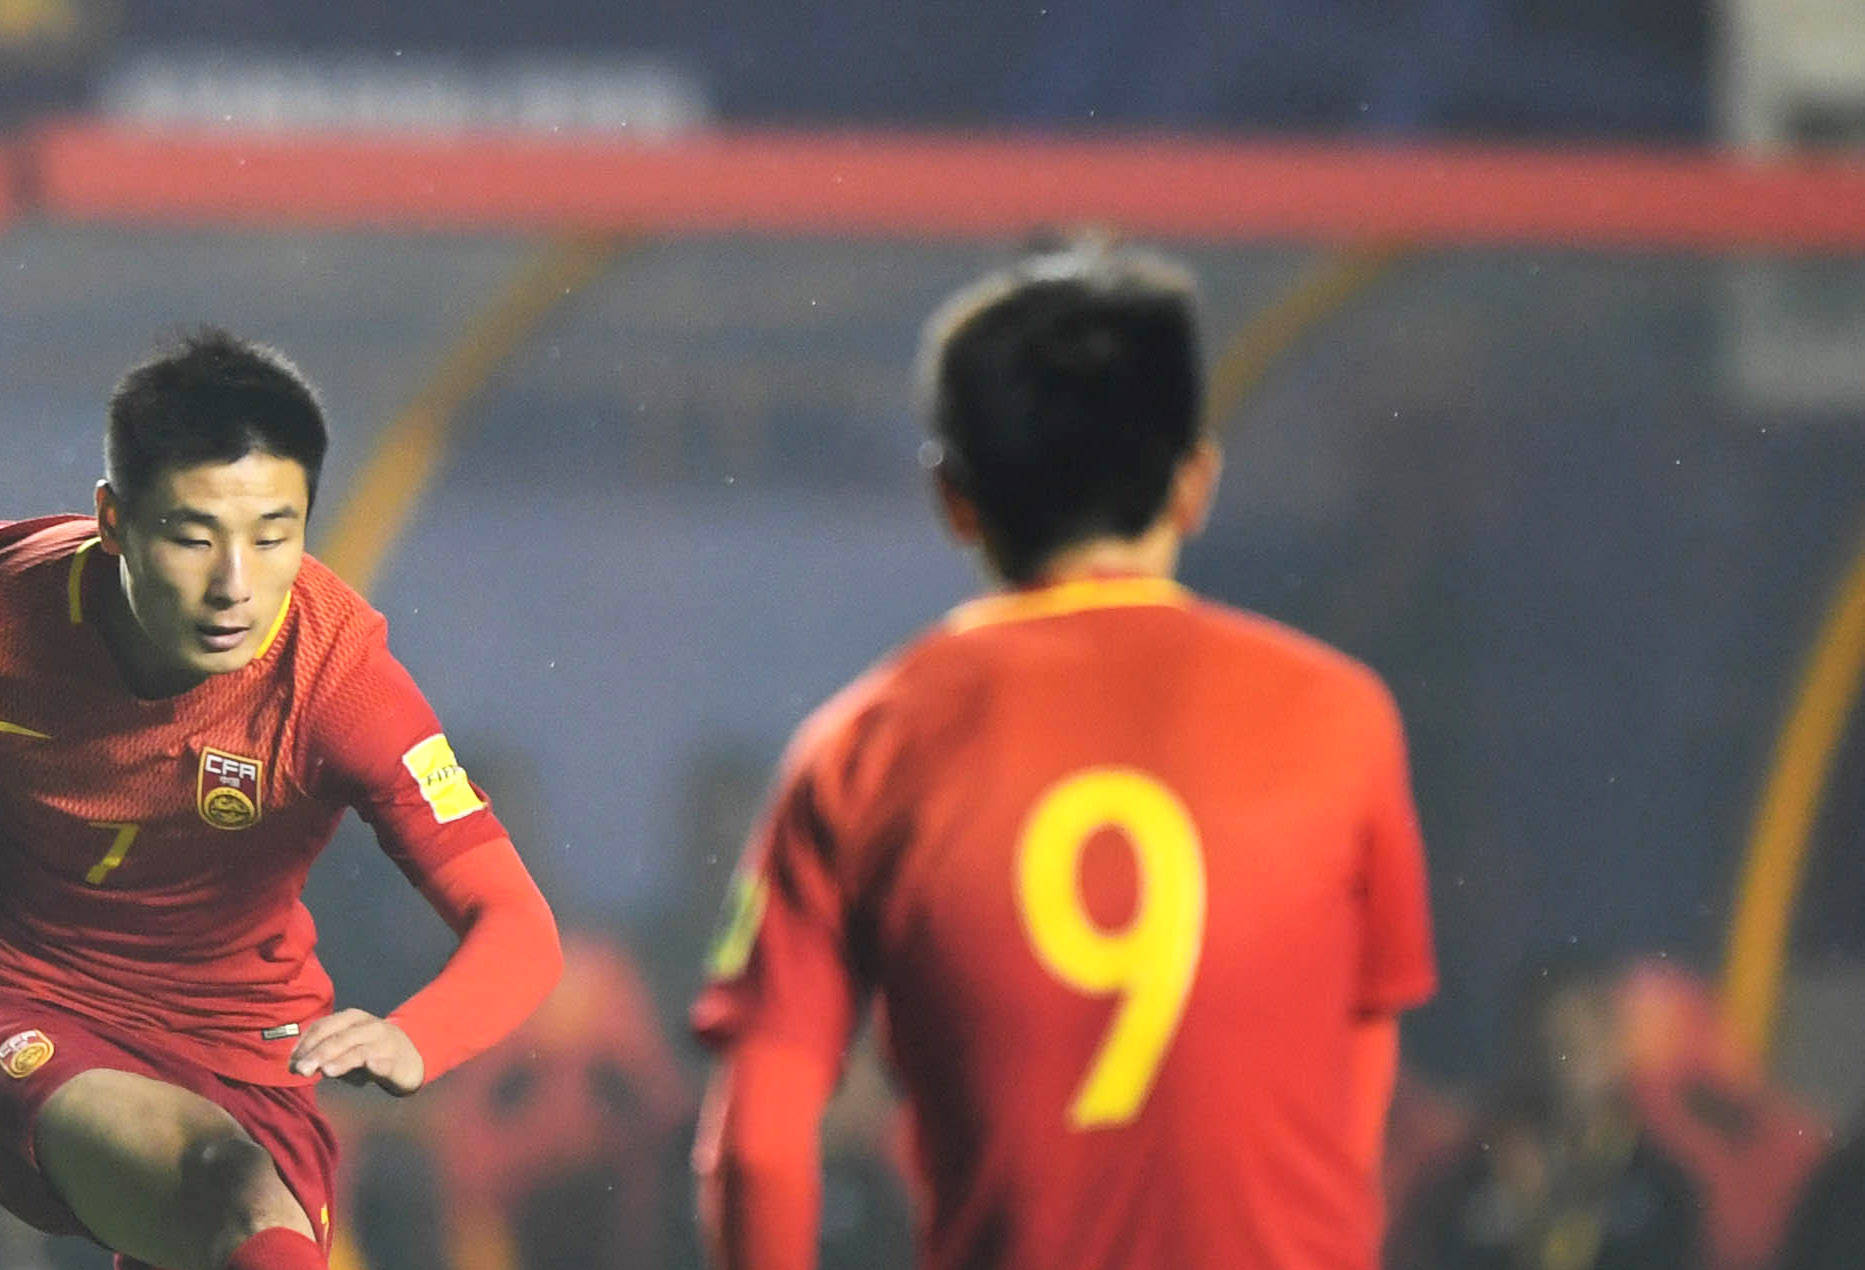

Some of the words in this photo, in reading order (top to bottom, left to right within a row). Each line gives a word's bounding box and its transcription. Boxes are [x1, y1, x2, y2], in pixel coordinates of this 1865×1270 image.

[205, 754, 256, 781] CFA
[86, 822, 140, 884] 7
[1014, 765, 1207, 1130] 9
